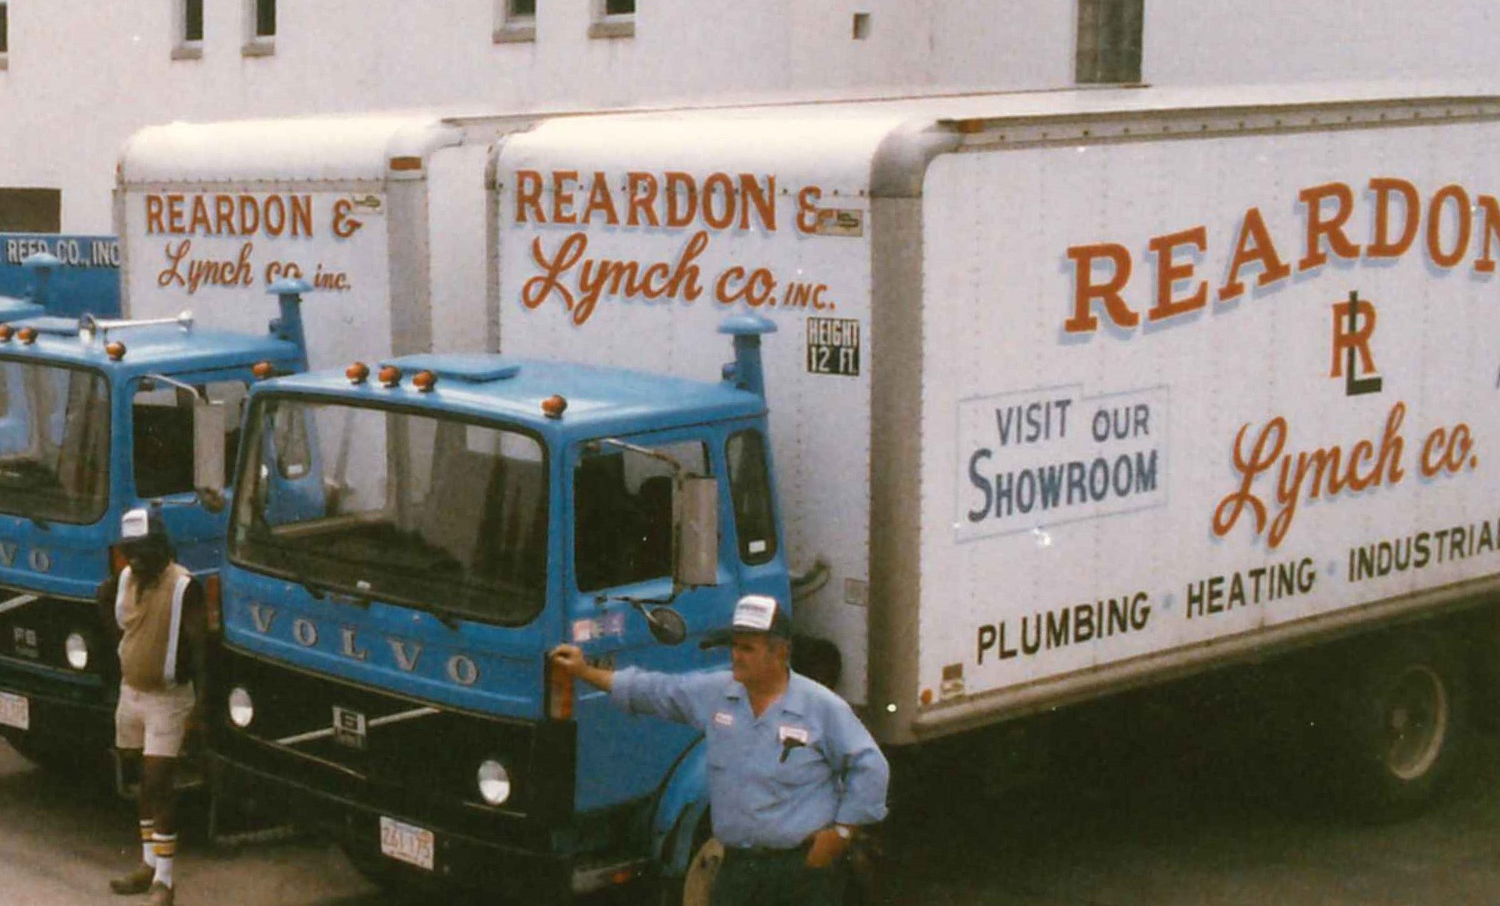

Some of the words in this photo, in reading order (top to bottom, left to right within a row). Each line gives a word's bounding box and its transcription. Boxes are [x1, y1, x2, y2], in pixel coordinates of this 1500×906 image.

[145, 194, 313, 237] REARDON
[332, 198, 363, 238] &
[514, 170, 777, 231] REARDON
[796, 185, 824, 234] &
[158, 239, 253, 294] Lynch
[522, 230, 709, 326] Lynch
[783, 281, 837, 310] INC.
[809, 319, 858, 347] HEIGHT
[811, 346, 830, 371] 12
[995, 399, 1072, 446] VISIT
[1091, 404, 1150, 443] OUR
[1212, 401, 1407, 549] Lynch
[977, 591, 1151, 665] PLUMBING
[1187, 557, 1316, 619] HEATING
[1348, 517, 1500, 583] INDUSTRIA
[251, 602, 479, 686] VOLVO
